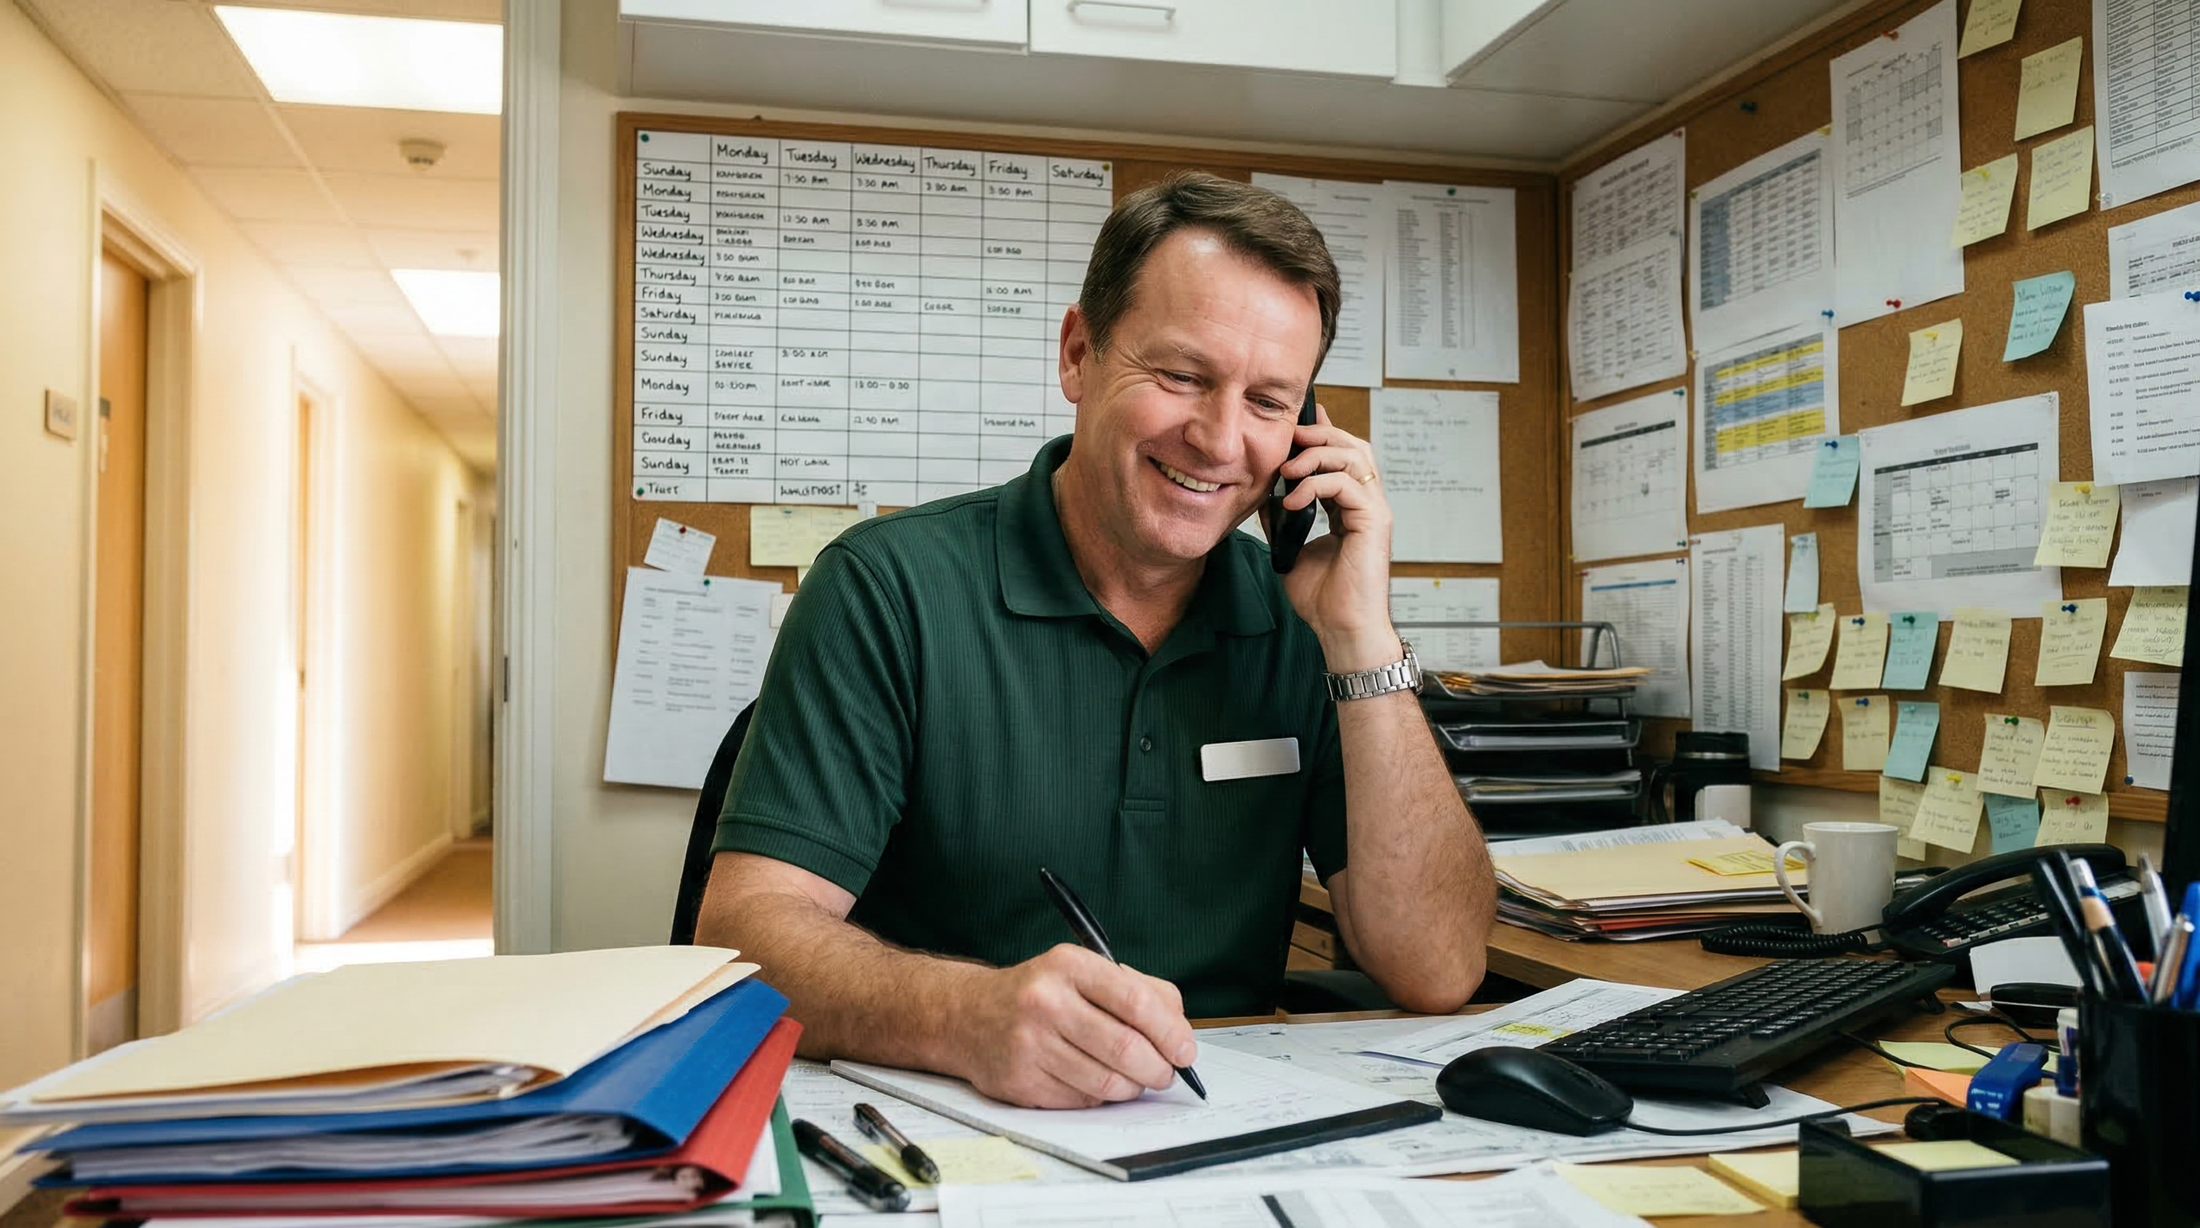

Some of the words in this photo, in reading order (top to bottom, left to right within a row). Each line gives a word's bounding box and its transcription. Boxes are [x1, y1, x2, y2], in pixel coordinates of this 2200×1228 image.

[717, 144, 768, 165] Monday
[786, 148, 838, 169] Tuesday
[854, 152, 916, 173] Wednesday
[642, 162, 692, 182] Sunday
[924, 156, 976, 177] Thursday
[988, 160, 1029, 180] Friday
[1052, 165, 1104, 187] Saturday
[642, 183, 692, 203] Monday
[641, 204, 691, 223] Tuesday
[641, 226, 704, 246] Wednesday
[641, 247, 706, 267] Wednesday
[640, 267, 697, 287] Thursday
[641, 287, 682, 305] Friday
[640, 307, 697, 325] Saturday
[641, 327, 688, 345] Sunday
[641, 349, 688, 368] Sunday
[641, 378, 690, 396] Monday
[641, 408, 683, 425] Friday
[641, 456, 690, 475] Sunday
